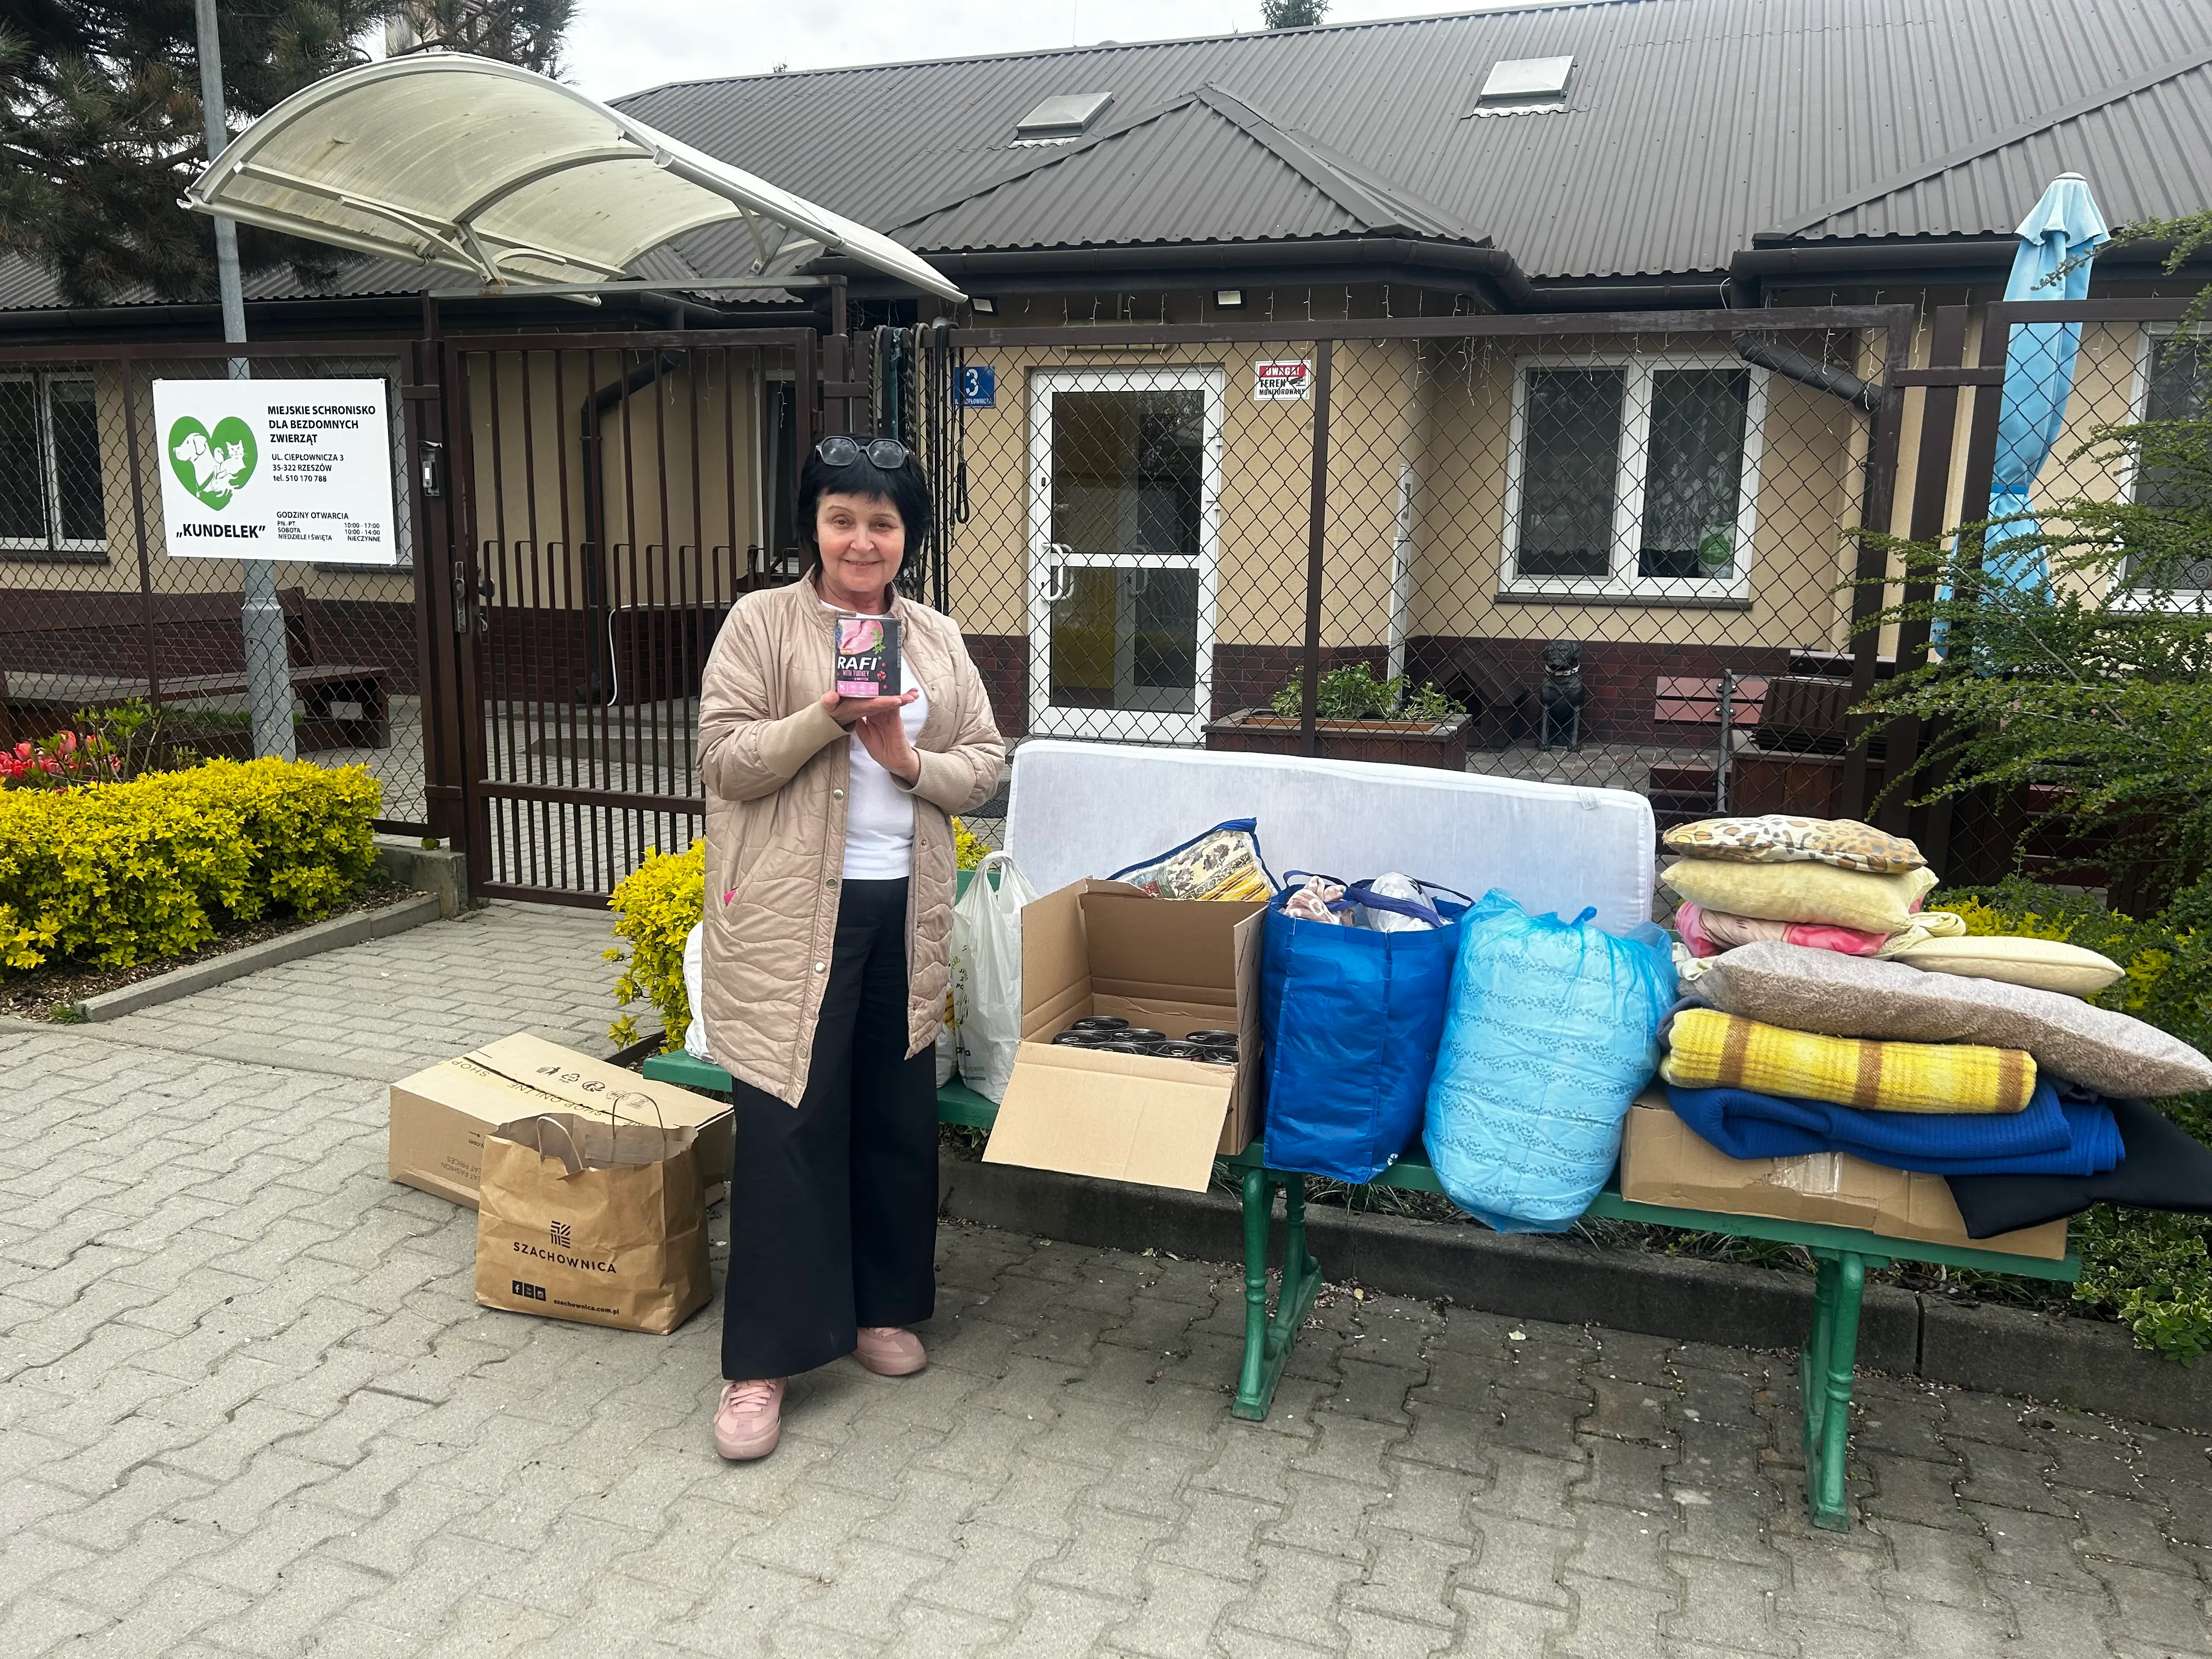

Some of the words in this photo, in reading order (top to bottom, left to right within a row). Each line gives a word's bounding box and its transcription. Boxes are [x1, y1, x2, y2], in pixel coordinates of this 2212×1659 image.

[1266, 367, 1299, 376] UWAGA!
[966, 369, 979, 396] 3
[1260, 379, 1285, 387] TEREN
[268, 406, 310, 415] MIEJSKIE
[312, 406, 376, 415] SCHRONISKO
[269, 420, 288, 428] DLA
[290, 420, 358, 428] BEZDOMNYCH
[270, 434, 317, 445] ZWIERZĄT
[298, 463, 331, 471] RZESZÓW
[838, 656, 877, 670] RAFI
[452, 1061, 490, 1076] SHOP
[506, 1082, 561, 1102] ONLINE
[441, 1161, 469, 1178] FASHION
[447, 1156, 469, 1170] PRICES
[514, 1242, 617, 1273] SZACHOWNICA
[554, 1300, 619, 1315] szachownica.com.pl
